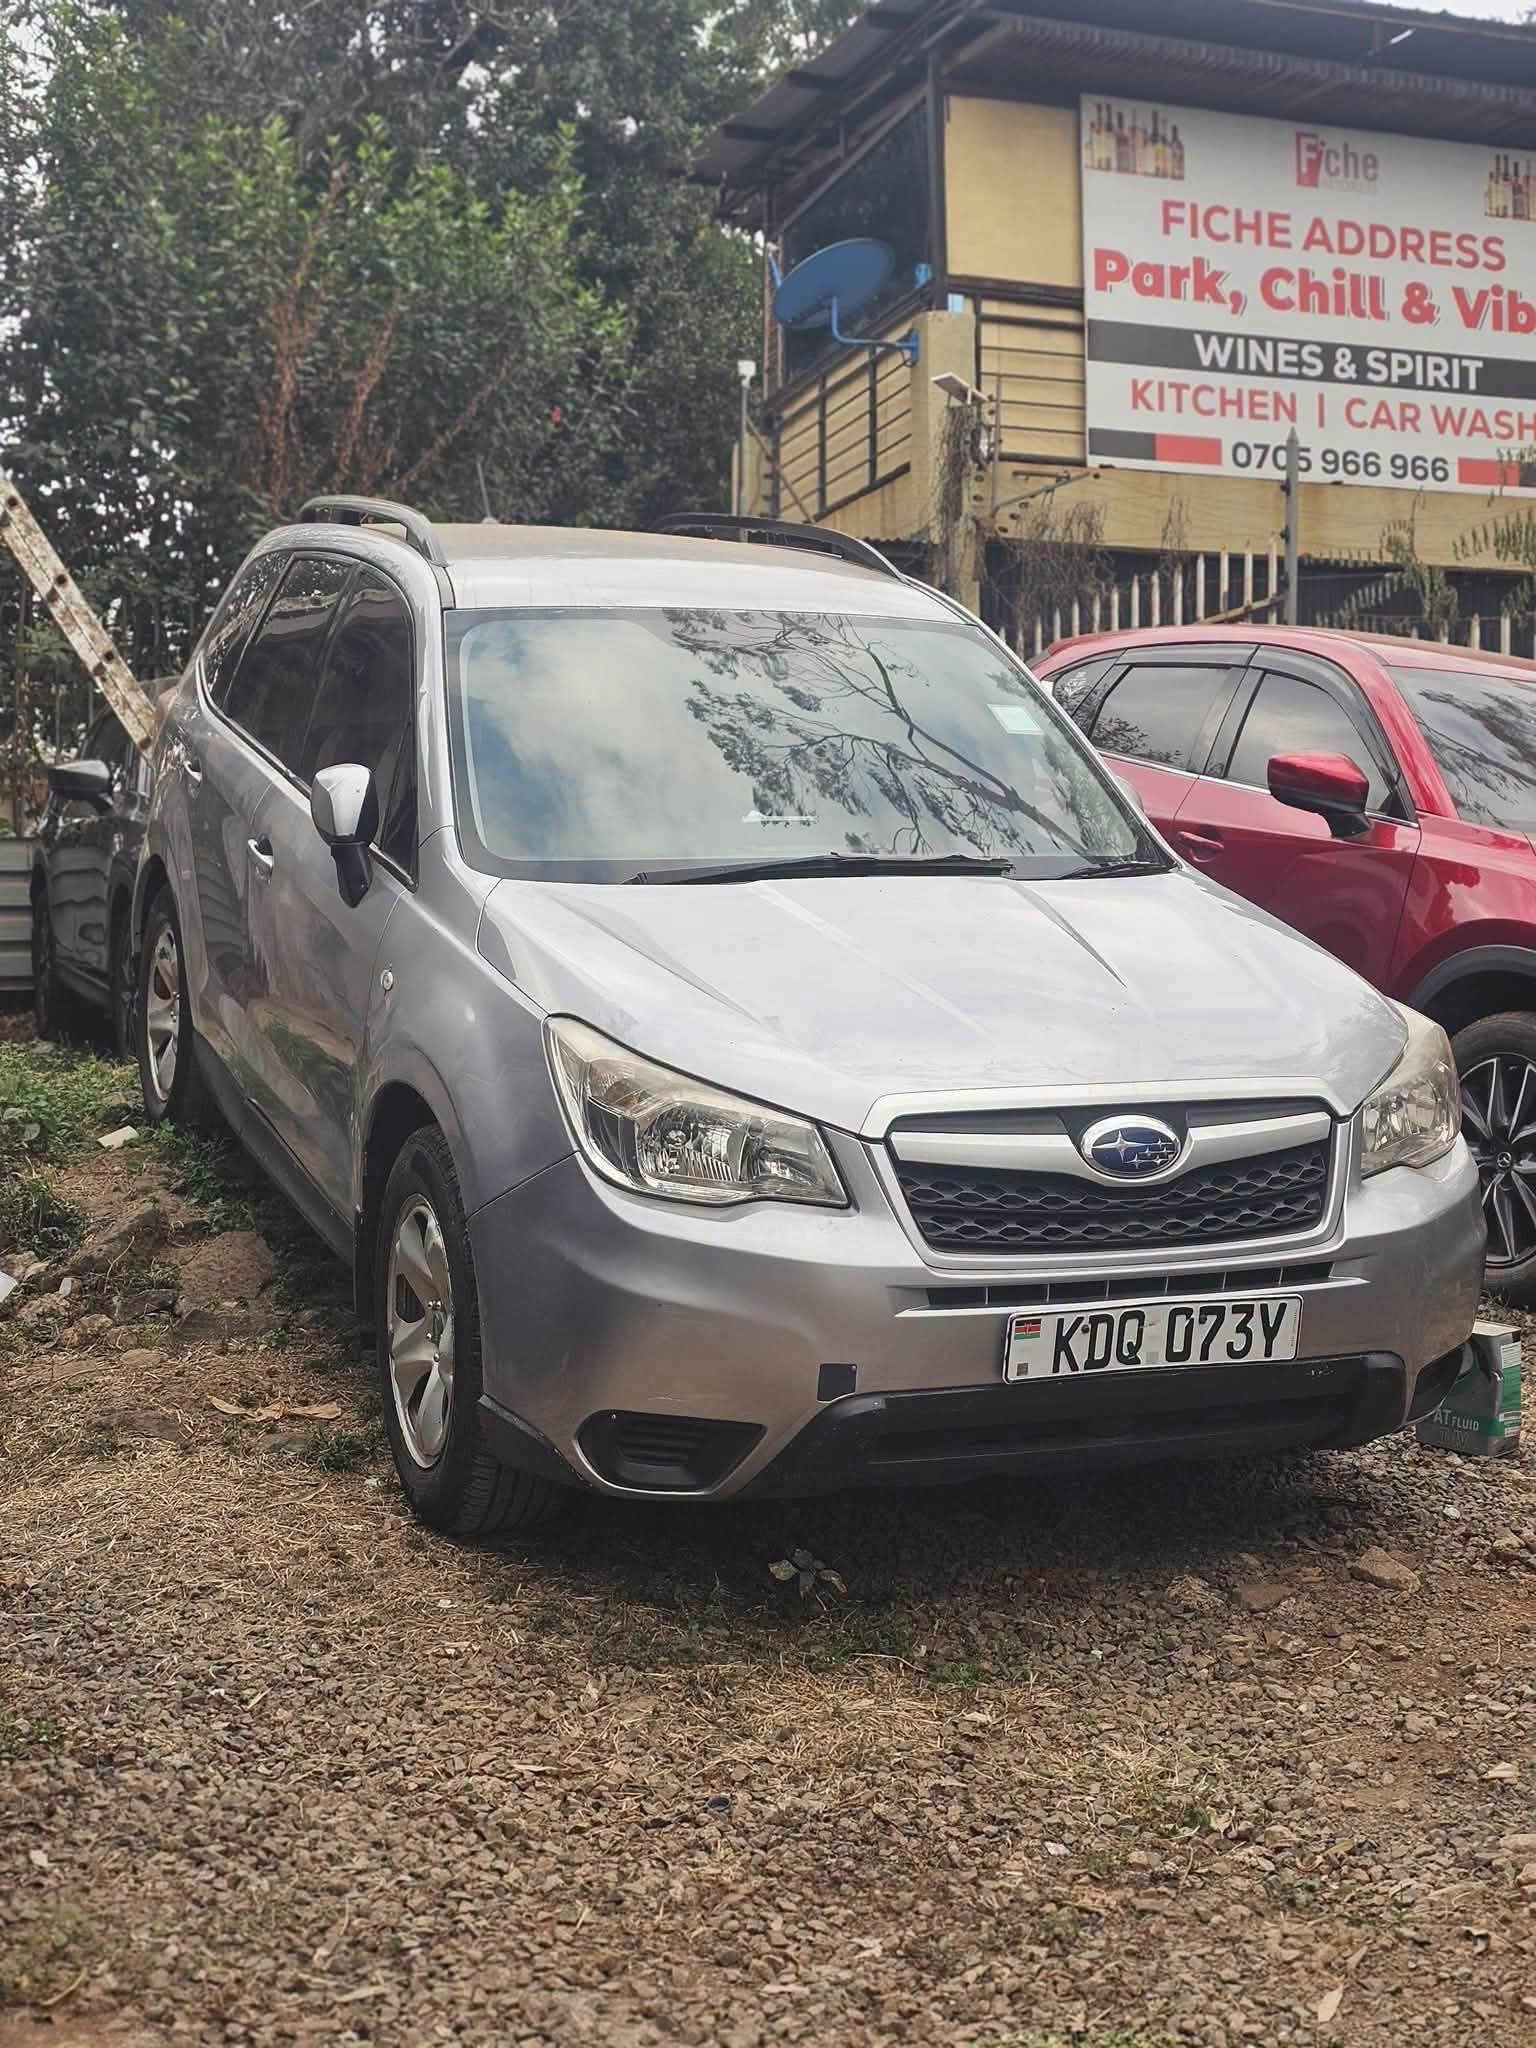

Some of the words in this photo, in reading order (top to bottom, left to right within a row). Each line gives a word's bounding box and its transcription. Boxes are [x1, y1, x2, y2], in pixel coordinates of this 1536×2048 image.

[1296, 132, 1379, 188] Fiche
[1161, 199, 1292, 249] FICHE
[1303, 216, 1507, 272] ADDRESS
[1093, 247, 1247, 316] Park,
[1260, 266, 1389, 321] Chill
[1401, 281, 1440, 326] &
[1193, 333, 1324, 376] WINES
[1333, 348, 1358, 381] &
[1366, 355, 1484, 391] SPIRIT
[1131, 378, 1297, 424] KITCHEN
[1345, 398, 1422, 433] CAR
[1431, 404, 1536, 441] WASH
[1321, 449, 1382, 477] 966
[1390, 455, 1449, 483] 966
[1052, 1309, 1146, 1373] KDQ
[1165, 1302, 1287, 1362] 073Y
[1433, 1408, 1452, 1425] AT
[1451, 1416, 1480, 1431] FLUID
